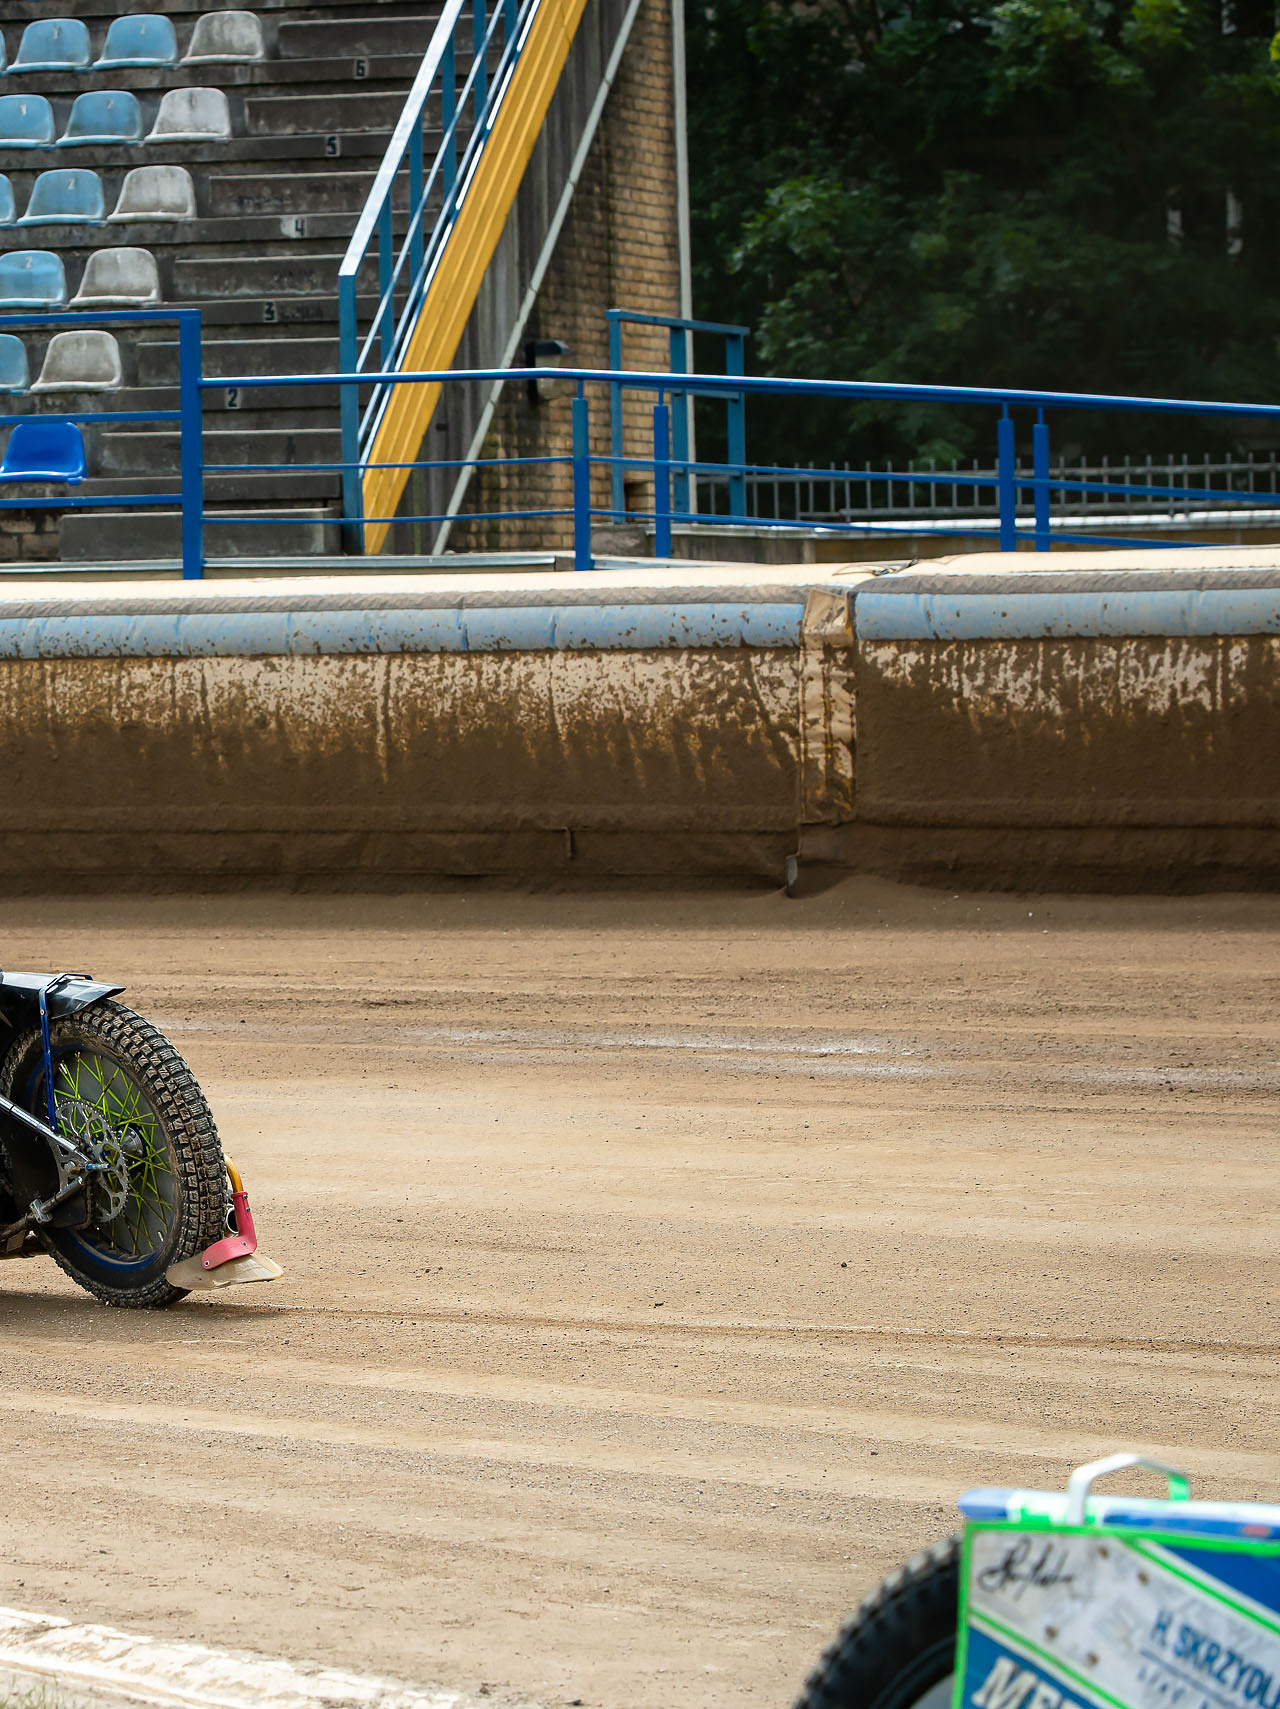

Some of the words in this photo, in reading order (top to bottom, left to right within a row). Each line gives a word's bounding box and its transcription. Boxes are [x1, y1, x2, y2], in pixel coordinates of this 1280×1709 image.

[356, 60, 365, 77] 6
[328, 136, 337, 155] 5
[295, 219, 305, 236] 4
[264, 302, 275, 321] 3
[228, 388, 237, 407] 2
[1174, 1622, 1280, 1709] SKRZYDL
